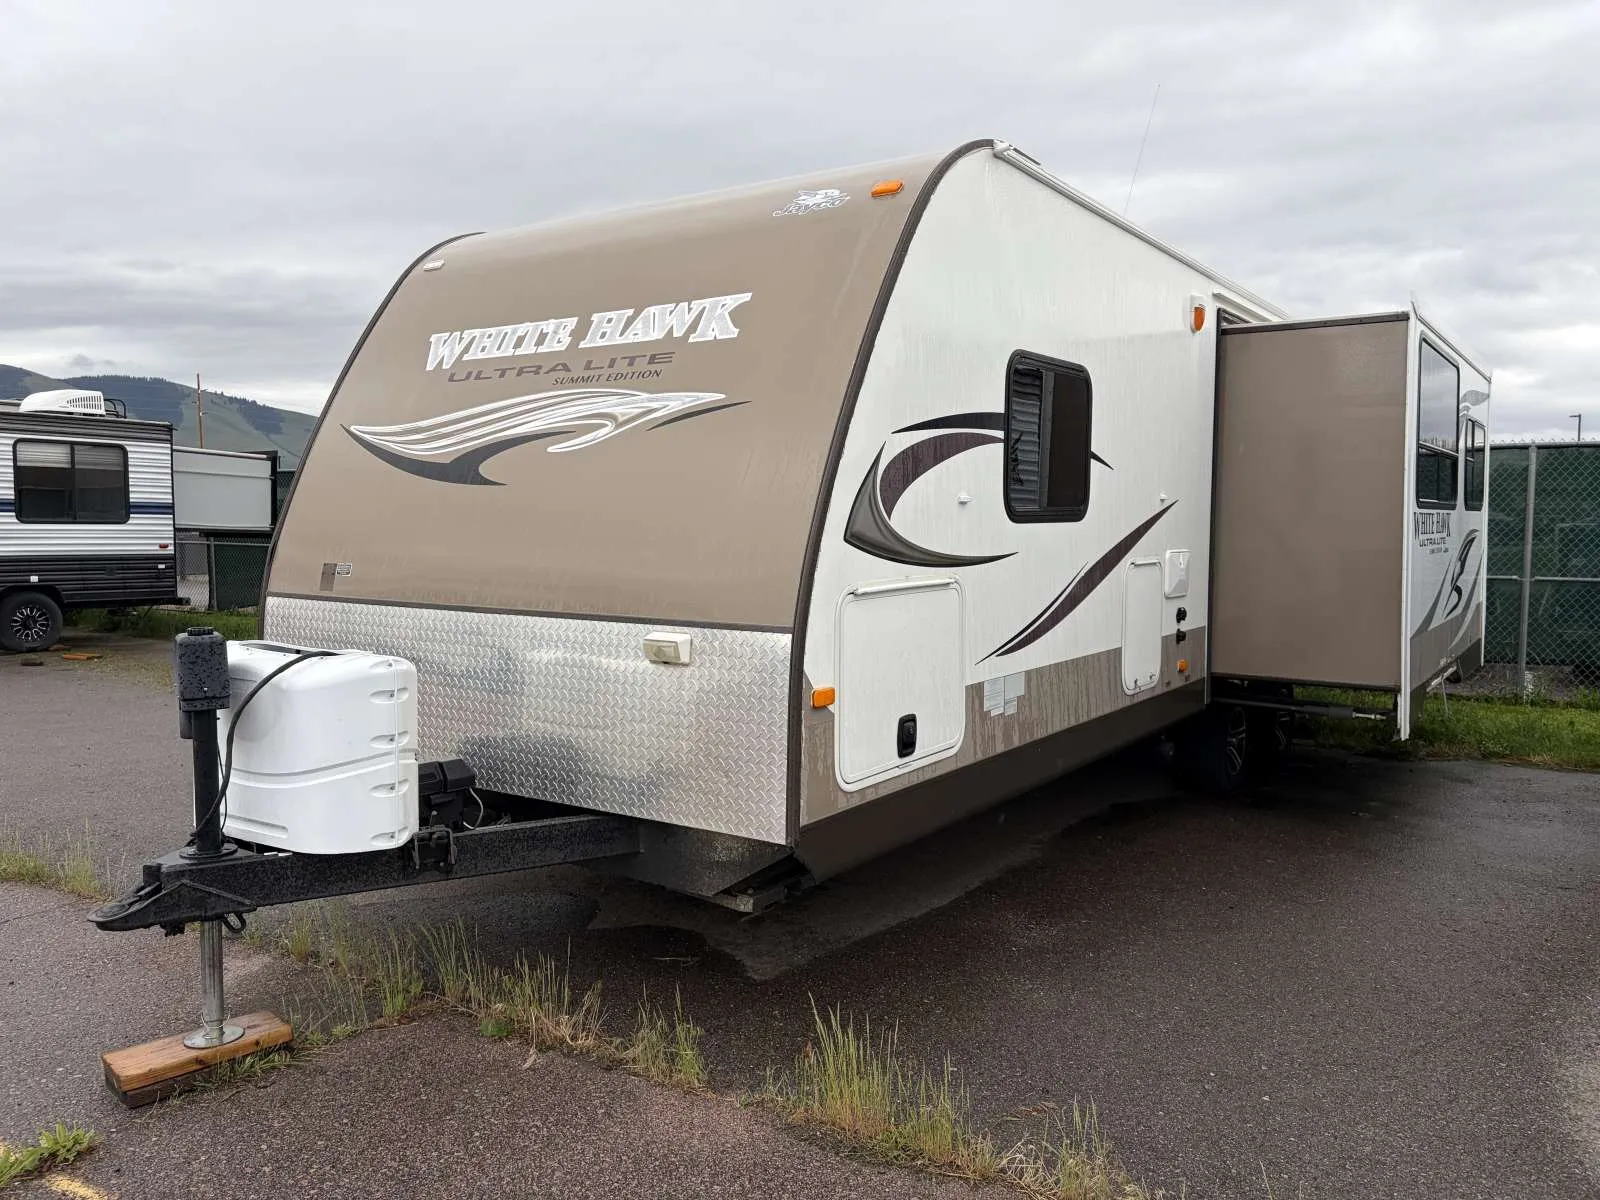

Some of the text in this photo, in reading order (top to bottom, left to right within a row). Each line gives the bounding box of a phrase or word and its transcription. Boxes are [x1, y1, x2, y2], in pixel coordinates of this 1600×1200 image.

[426, 292, 752, 371] WHITE HAWK
[447, 351, 677, 383] ULTRA LITE
[552, 369, 663, 385] SUMMIT EDITION
[1413, 511, 1451, 540] WHITE HAWK
